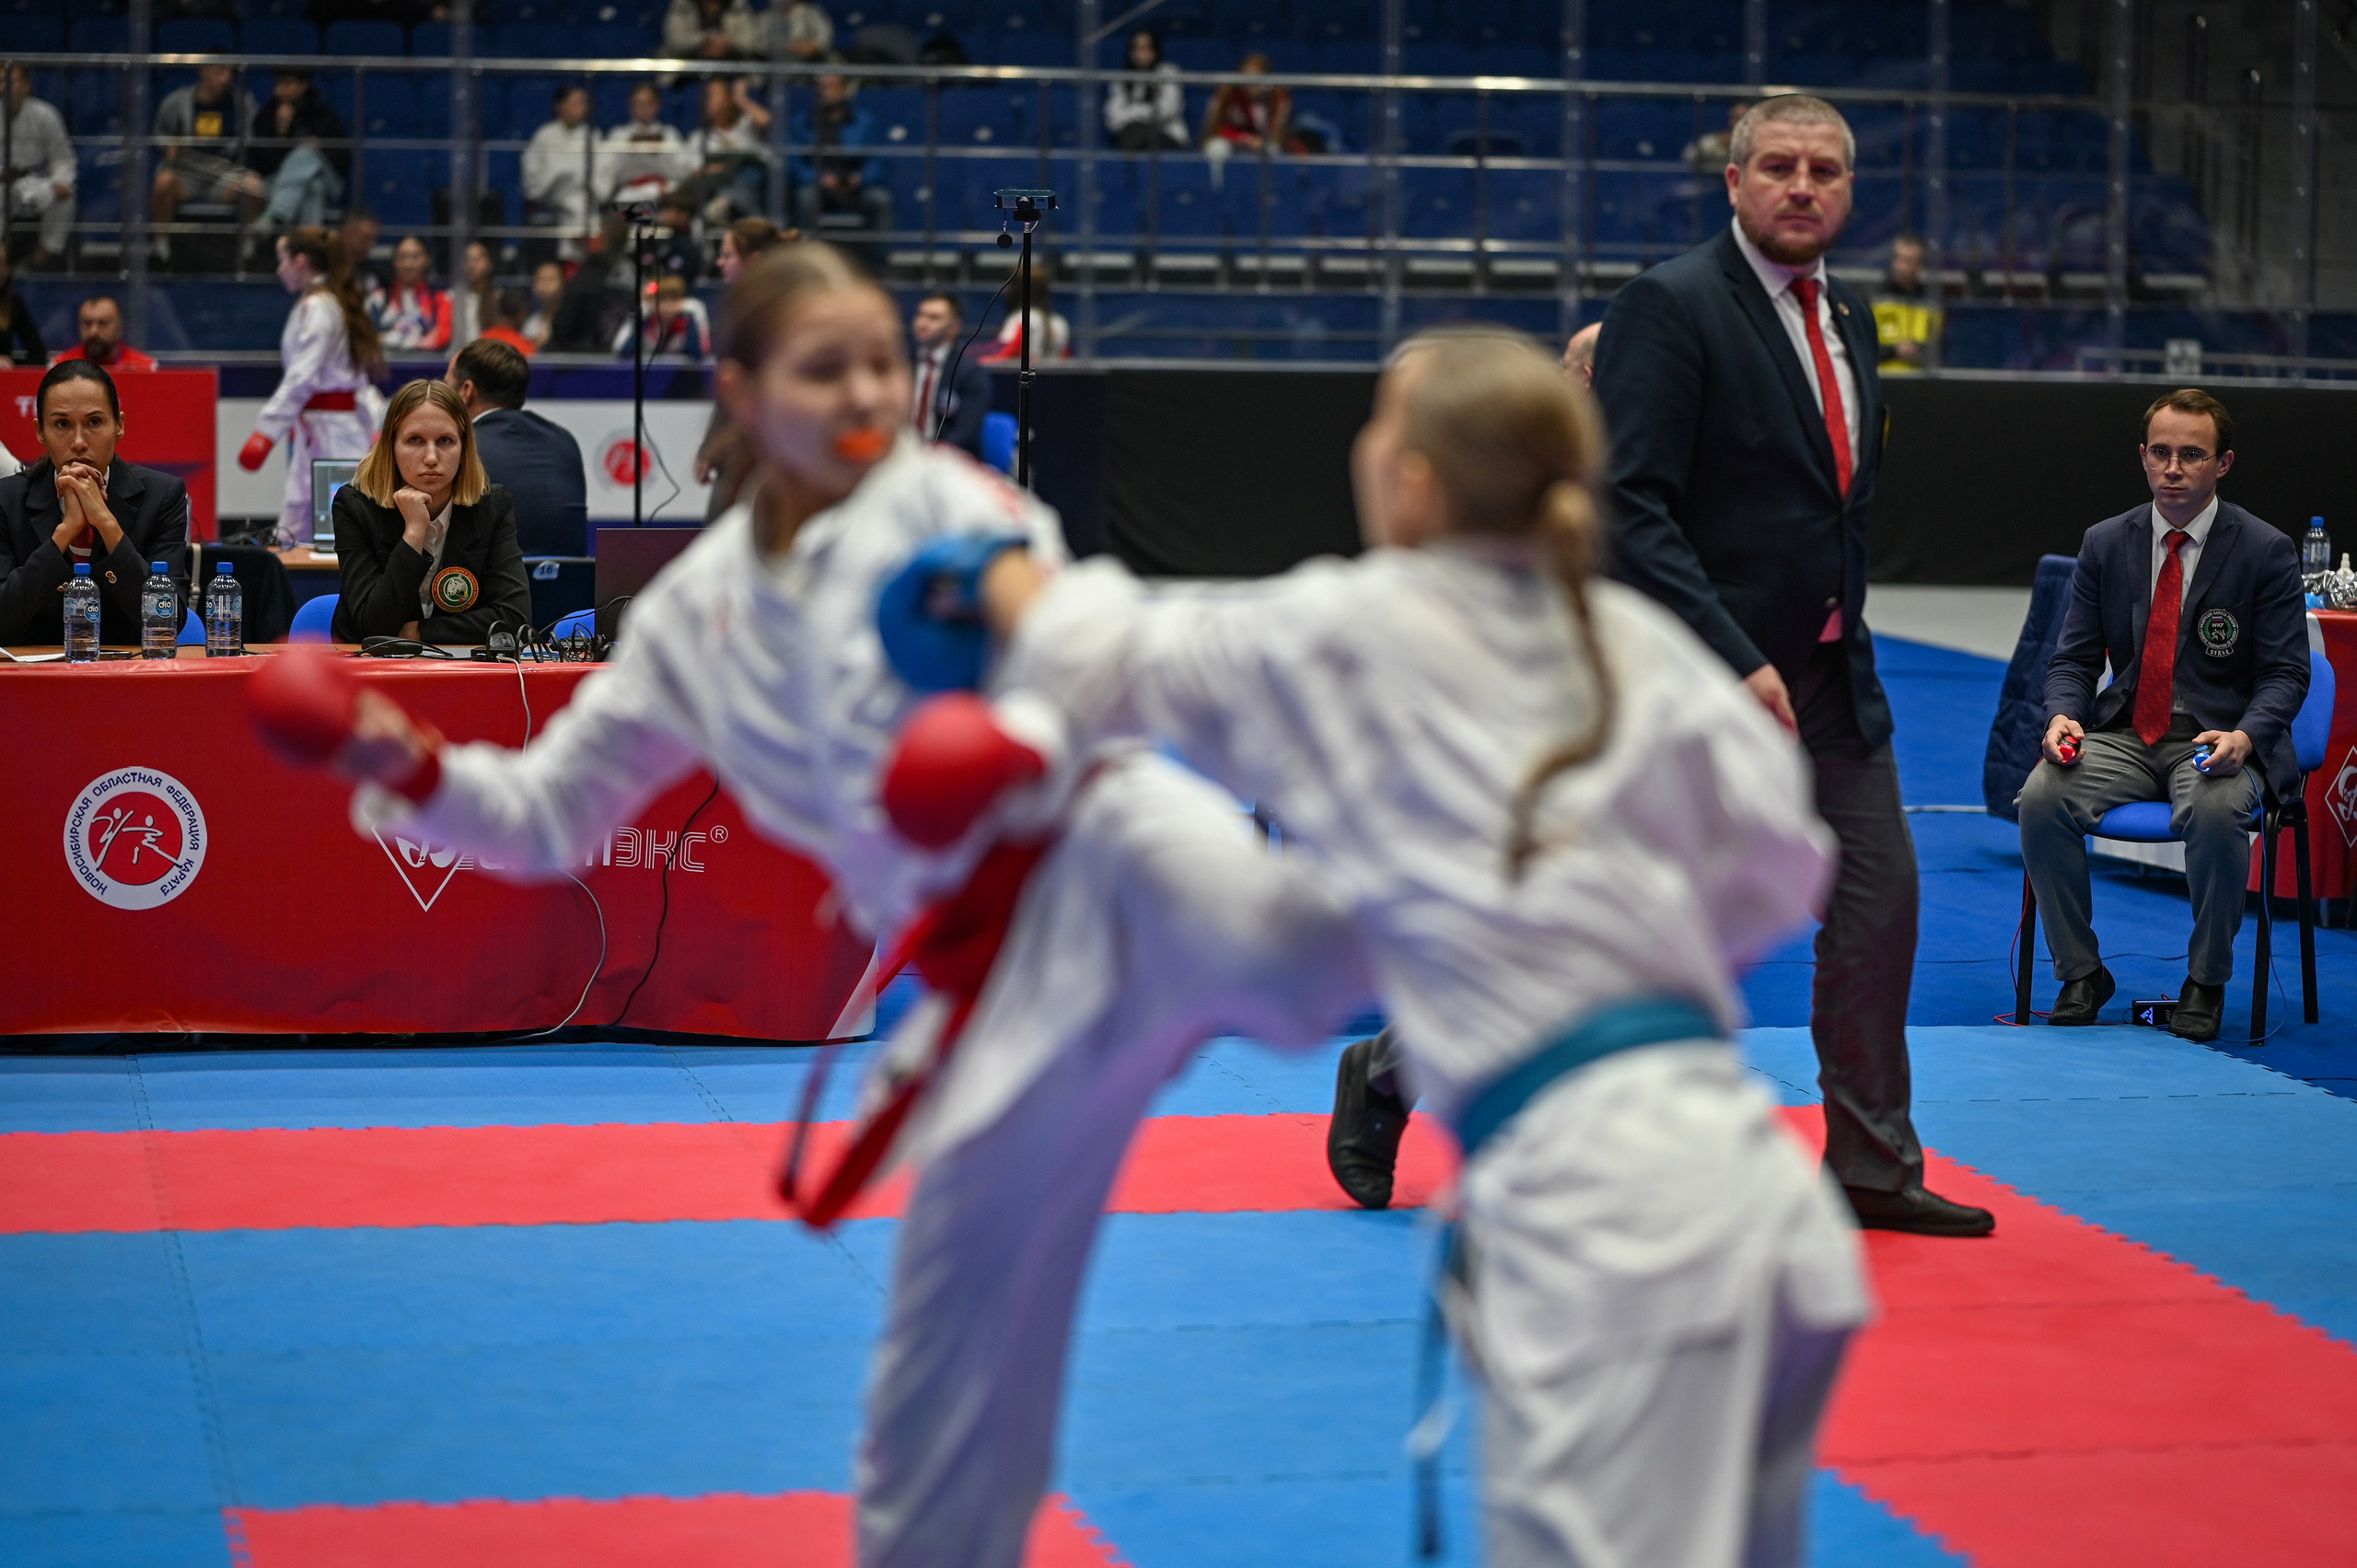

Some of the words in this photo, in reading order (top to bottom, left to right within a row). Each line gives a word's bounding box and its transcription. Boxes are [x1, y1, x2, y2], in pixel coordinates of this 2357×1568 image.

[158, 600, 171, 609] dio
[92, 772, 163, 797] ОБЛАСТНАЯ
[166, 785, 200, 851] ФЕДЕРАЦИЯ
[70, 797, 108, 896] НОВОСИБИРСКАЯ
[160, 858, 194, 896] КАРАТЭ
